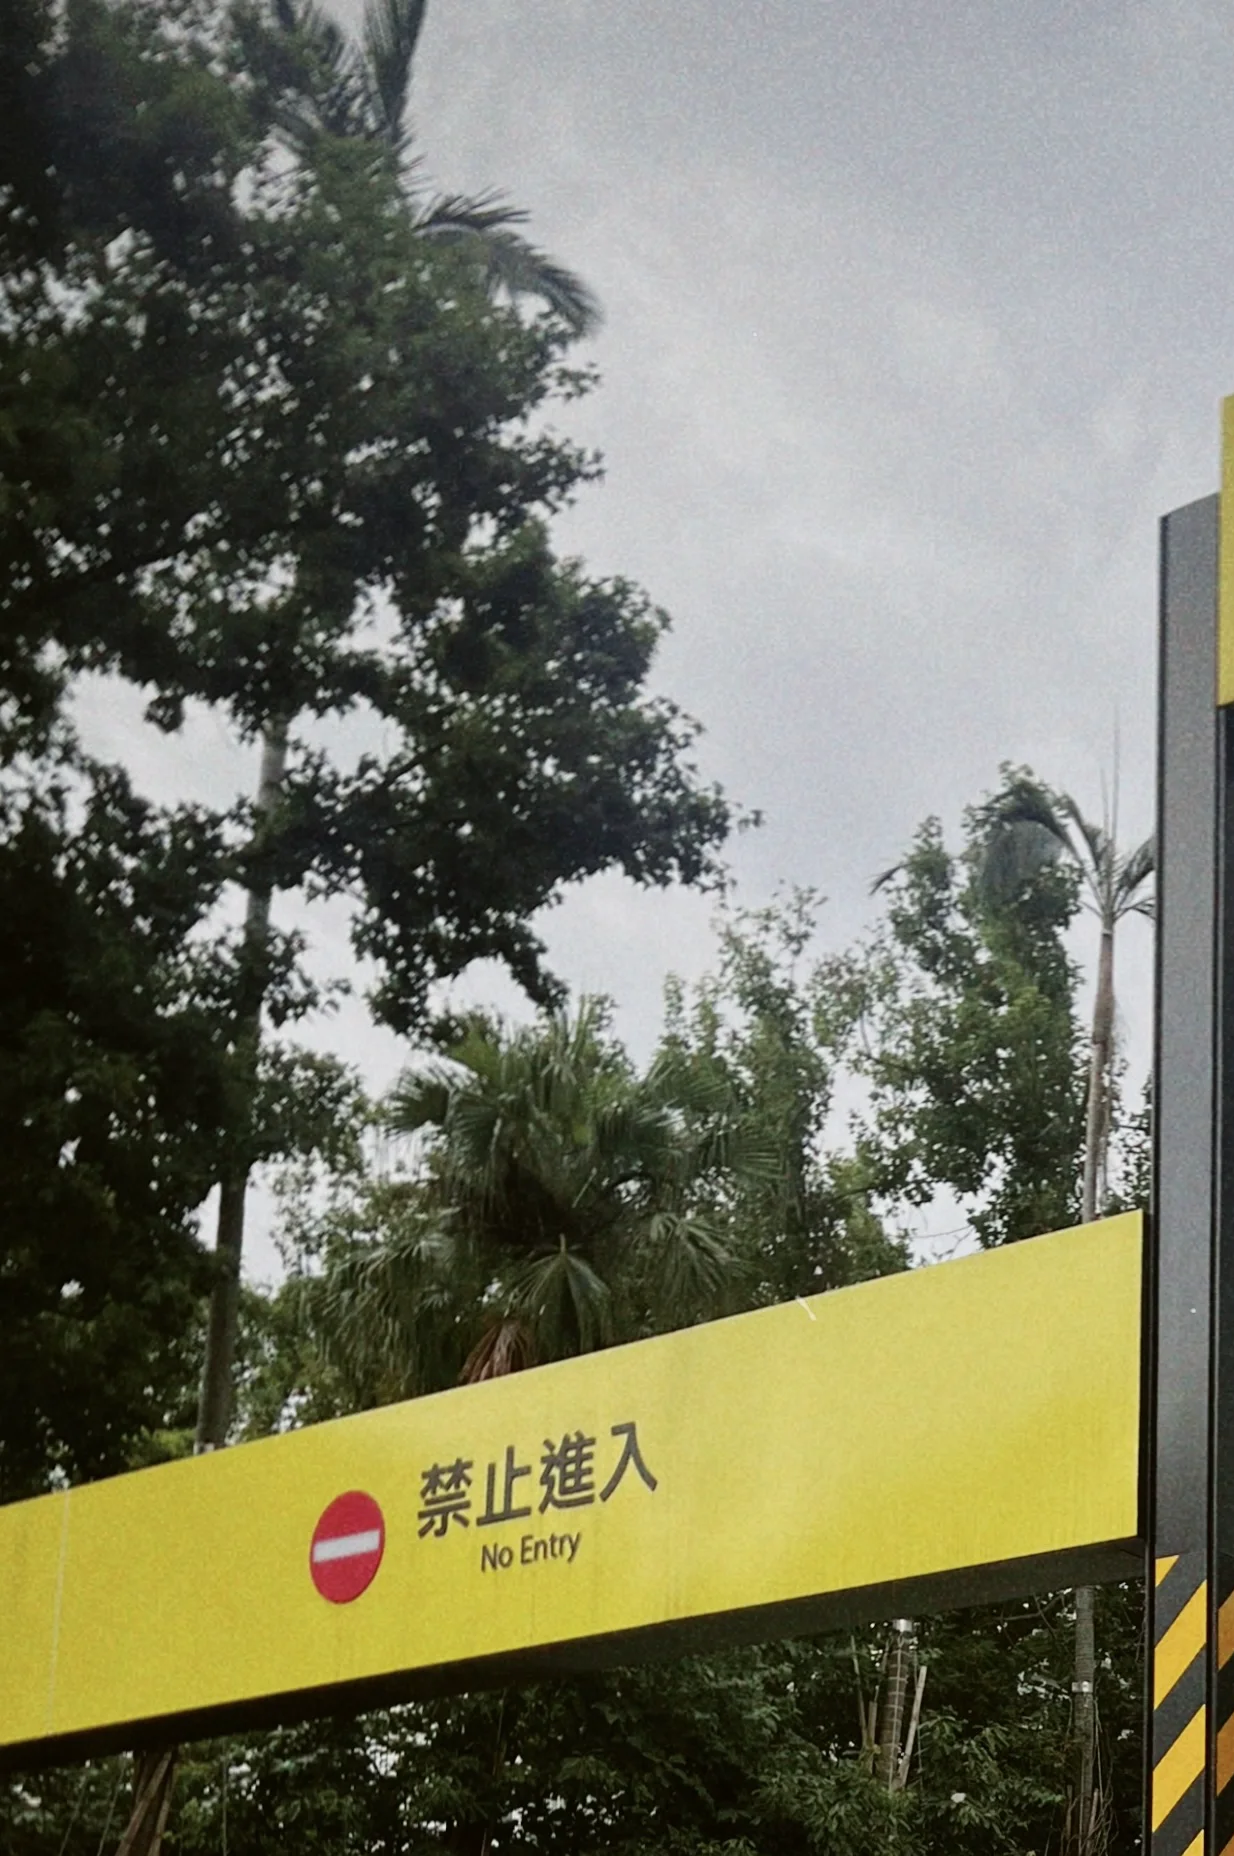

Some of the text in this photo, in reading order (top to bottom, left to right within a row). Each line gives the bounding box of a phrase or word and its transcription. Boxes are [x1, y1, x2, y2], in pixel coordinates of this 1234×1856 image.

[418, 1421, 658, 1538] 禁止進入
[481, 1532, 581, 1572] No Entry
